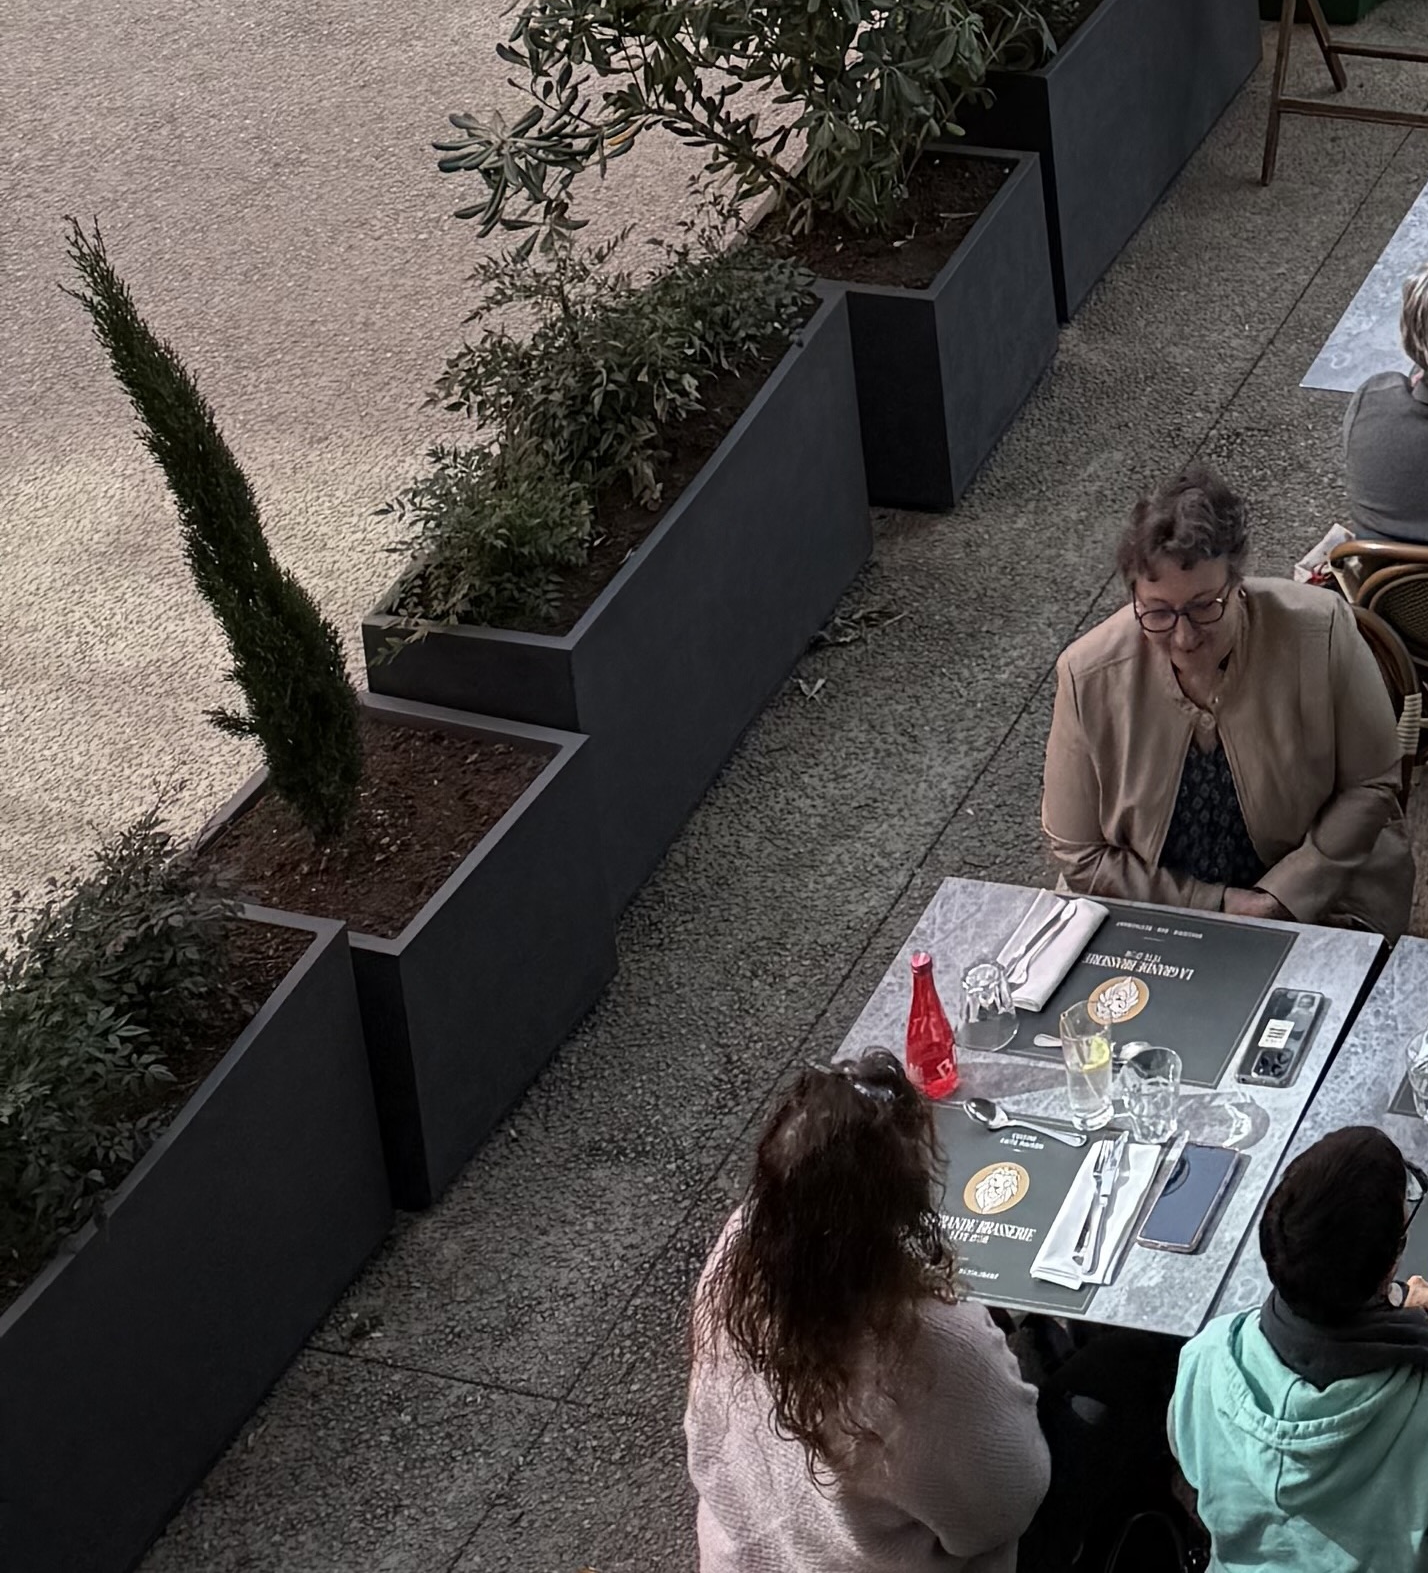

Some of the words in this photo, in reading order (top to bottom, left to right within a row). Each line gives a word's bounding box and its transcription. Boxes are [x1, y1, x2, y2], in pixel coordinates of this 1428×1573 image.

[1081, 952, 1137, 972] BRASSERIE
[1137, 960, 1180, 978] GRANDE
[1179, 966, 1195, 981] LA
[976, 1220, 1037, 1242] BRASSERIE
